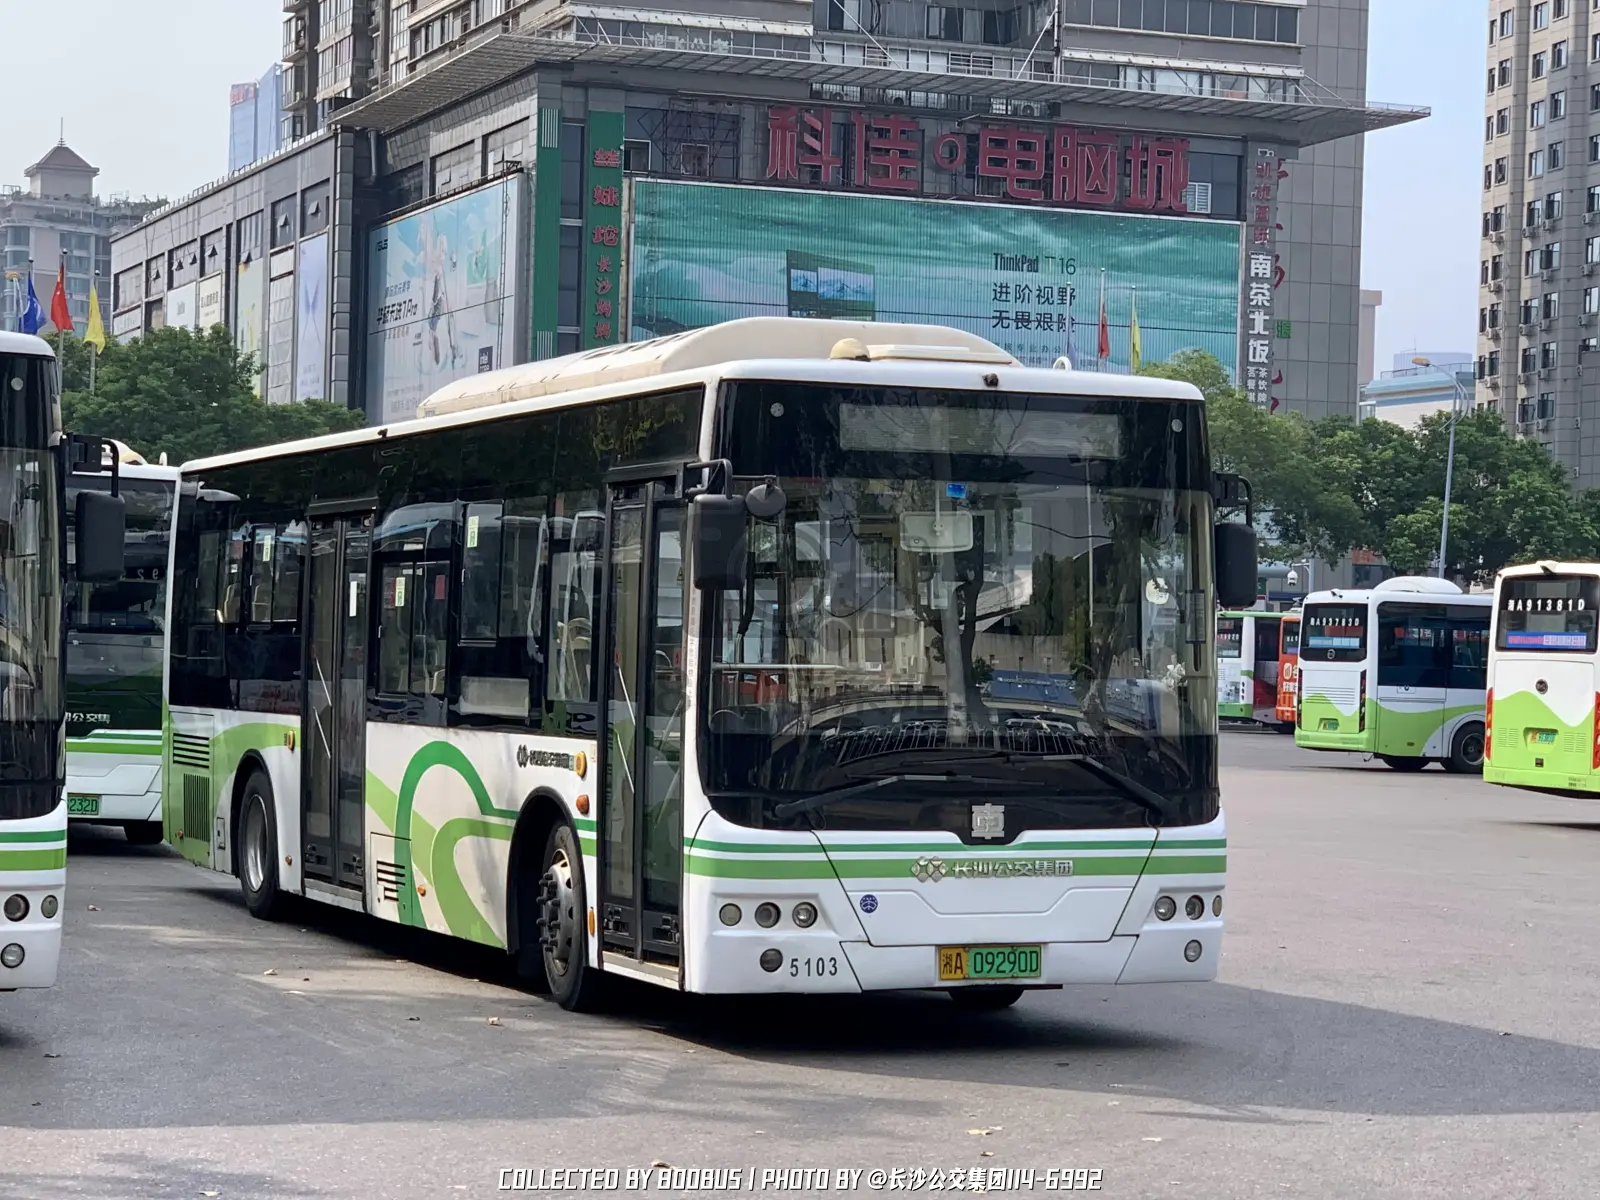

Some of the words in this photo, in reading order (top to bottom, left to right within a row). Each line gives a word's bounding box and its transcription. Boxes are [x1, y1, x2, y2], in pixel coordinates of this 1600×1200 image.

[993, 252, 1039, 273] ThinkPad
[992, 282, 1077, 307] 进阶视野
[1248, 253, 1272, 364] 南茶北饭
[992, 309, 1076, 333] 无畏艰险
[67, 798, 98, 813] 232D
[952, 859, 1074, 879] 长沙公交集团
[790, 956, 838, 978] 5103
